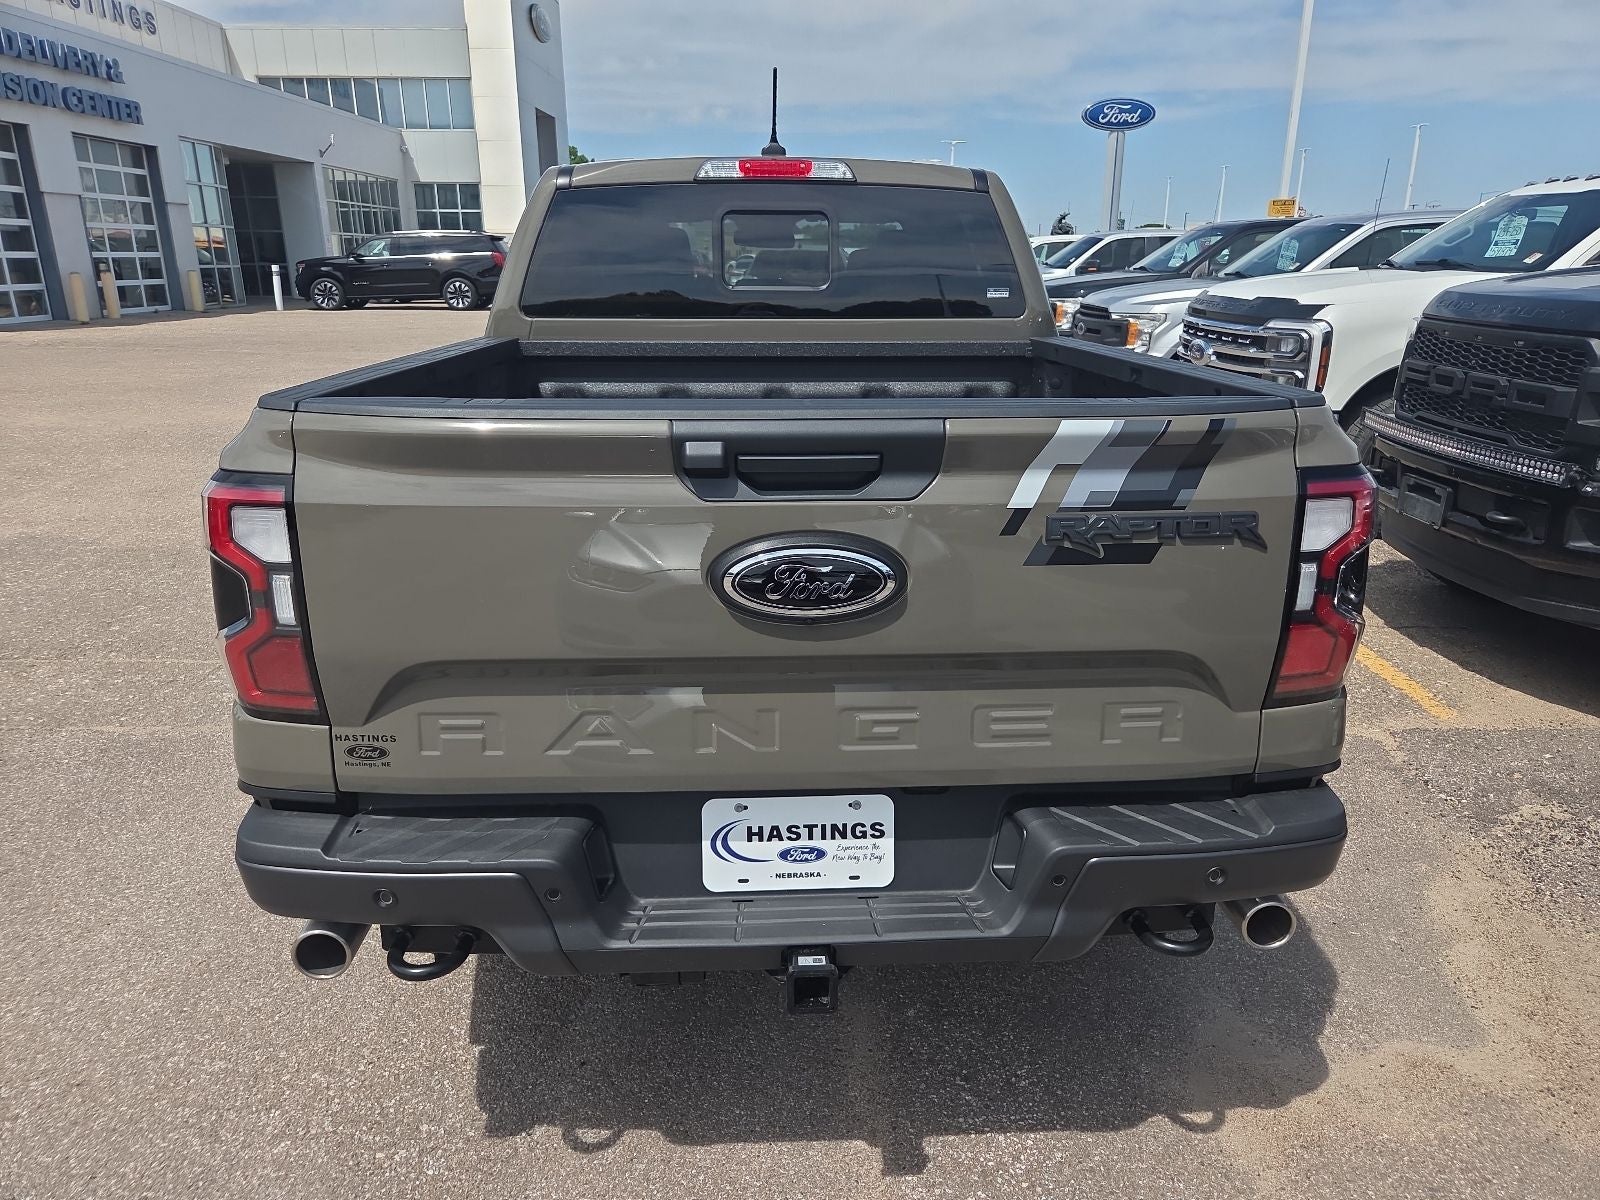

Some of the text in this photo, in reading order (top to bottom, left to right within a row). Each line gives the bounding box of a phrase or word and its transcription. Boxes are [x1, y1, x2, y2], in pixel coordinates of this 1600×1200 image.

[66, 0, 157, 35] TINGS
[2, 28, 125, 84] DELIVERY &
[61, 86, 144, 125] CENTER
[1099, 104, 1142, 123] Ford
[1045, 510, 1268, 559] RAPTOR
[765, 564, 855, 600] Ford
[335, 734, 397, 742] HASTINGS
[418, 701, 1183, 756] RANGER
[353, 747, 380, 758] Ford
[747, 821, 886, 842] HASTINGS
[787, 848, 818, 861] Ford
[836, 844, 869, 852] Experience
